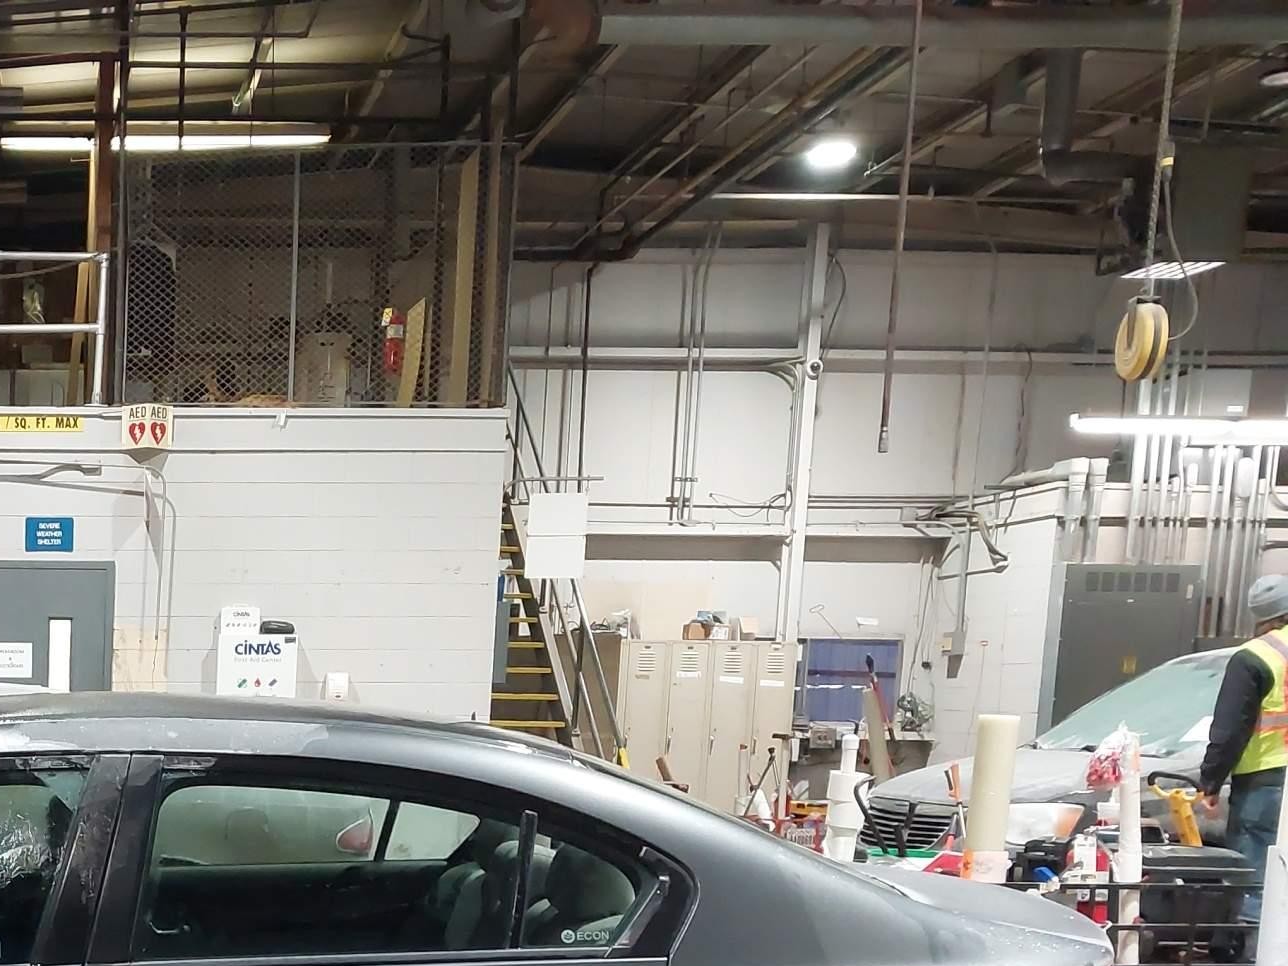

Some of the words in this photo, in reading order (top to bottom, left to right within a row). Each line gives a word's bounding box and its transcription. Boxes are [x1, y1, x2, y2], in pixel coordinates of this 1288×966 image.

[129, 406, 146, 419] AED
[150, 406, 167, 419] AED
[14, 416, 31, 429] SQ.
[35, 416, 51, 428] FT.
[55, 416, 79, 428] MAX
[234, 639, 282, 655] CINTAS
[576, 931, 610, 941] ECON
